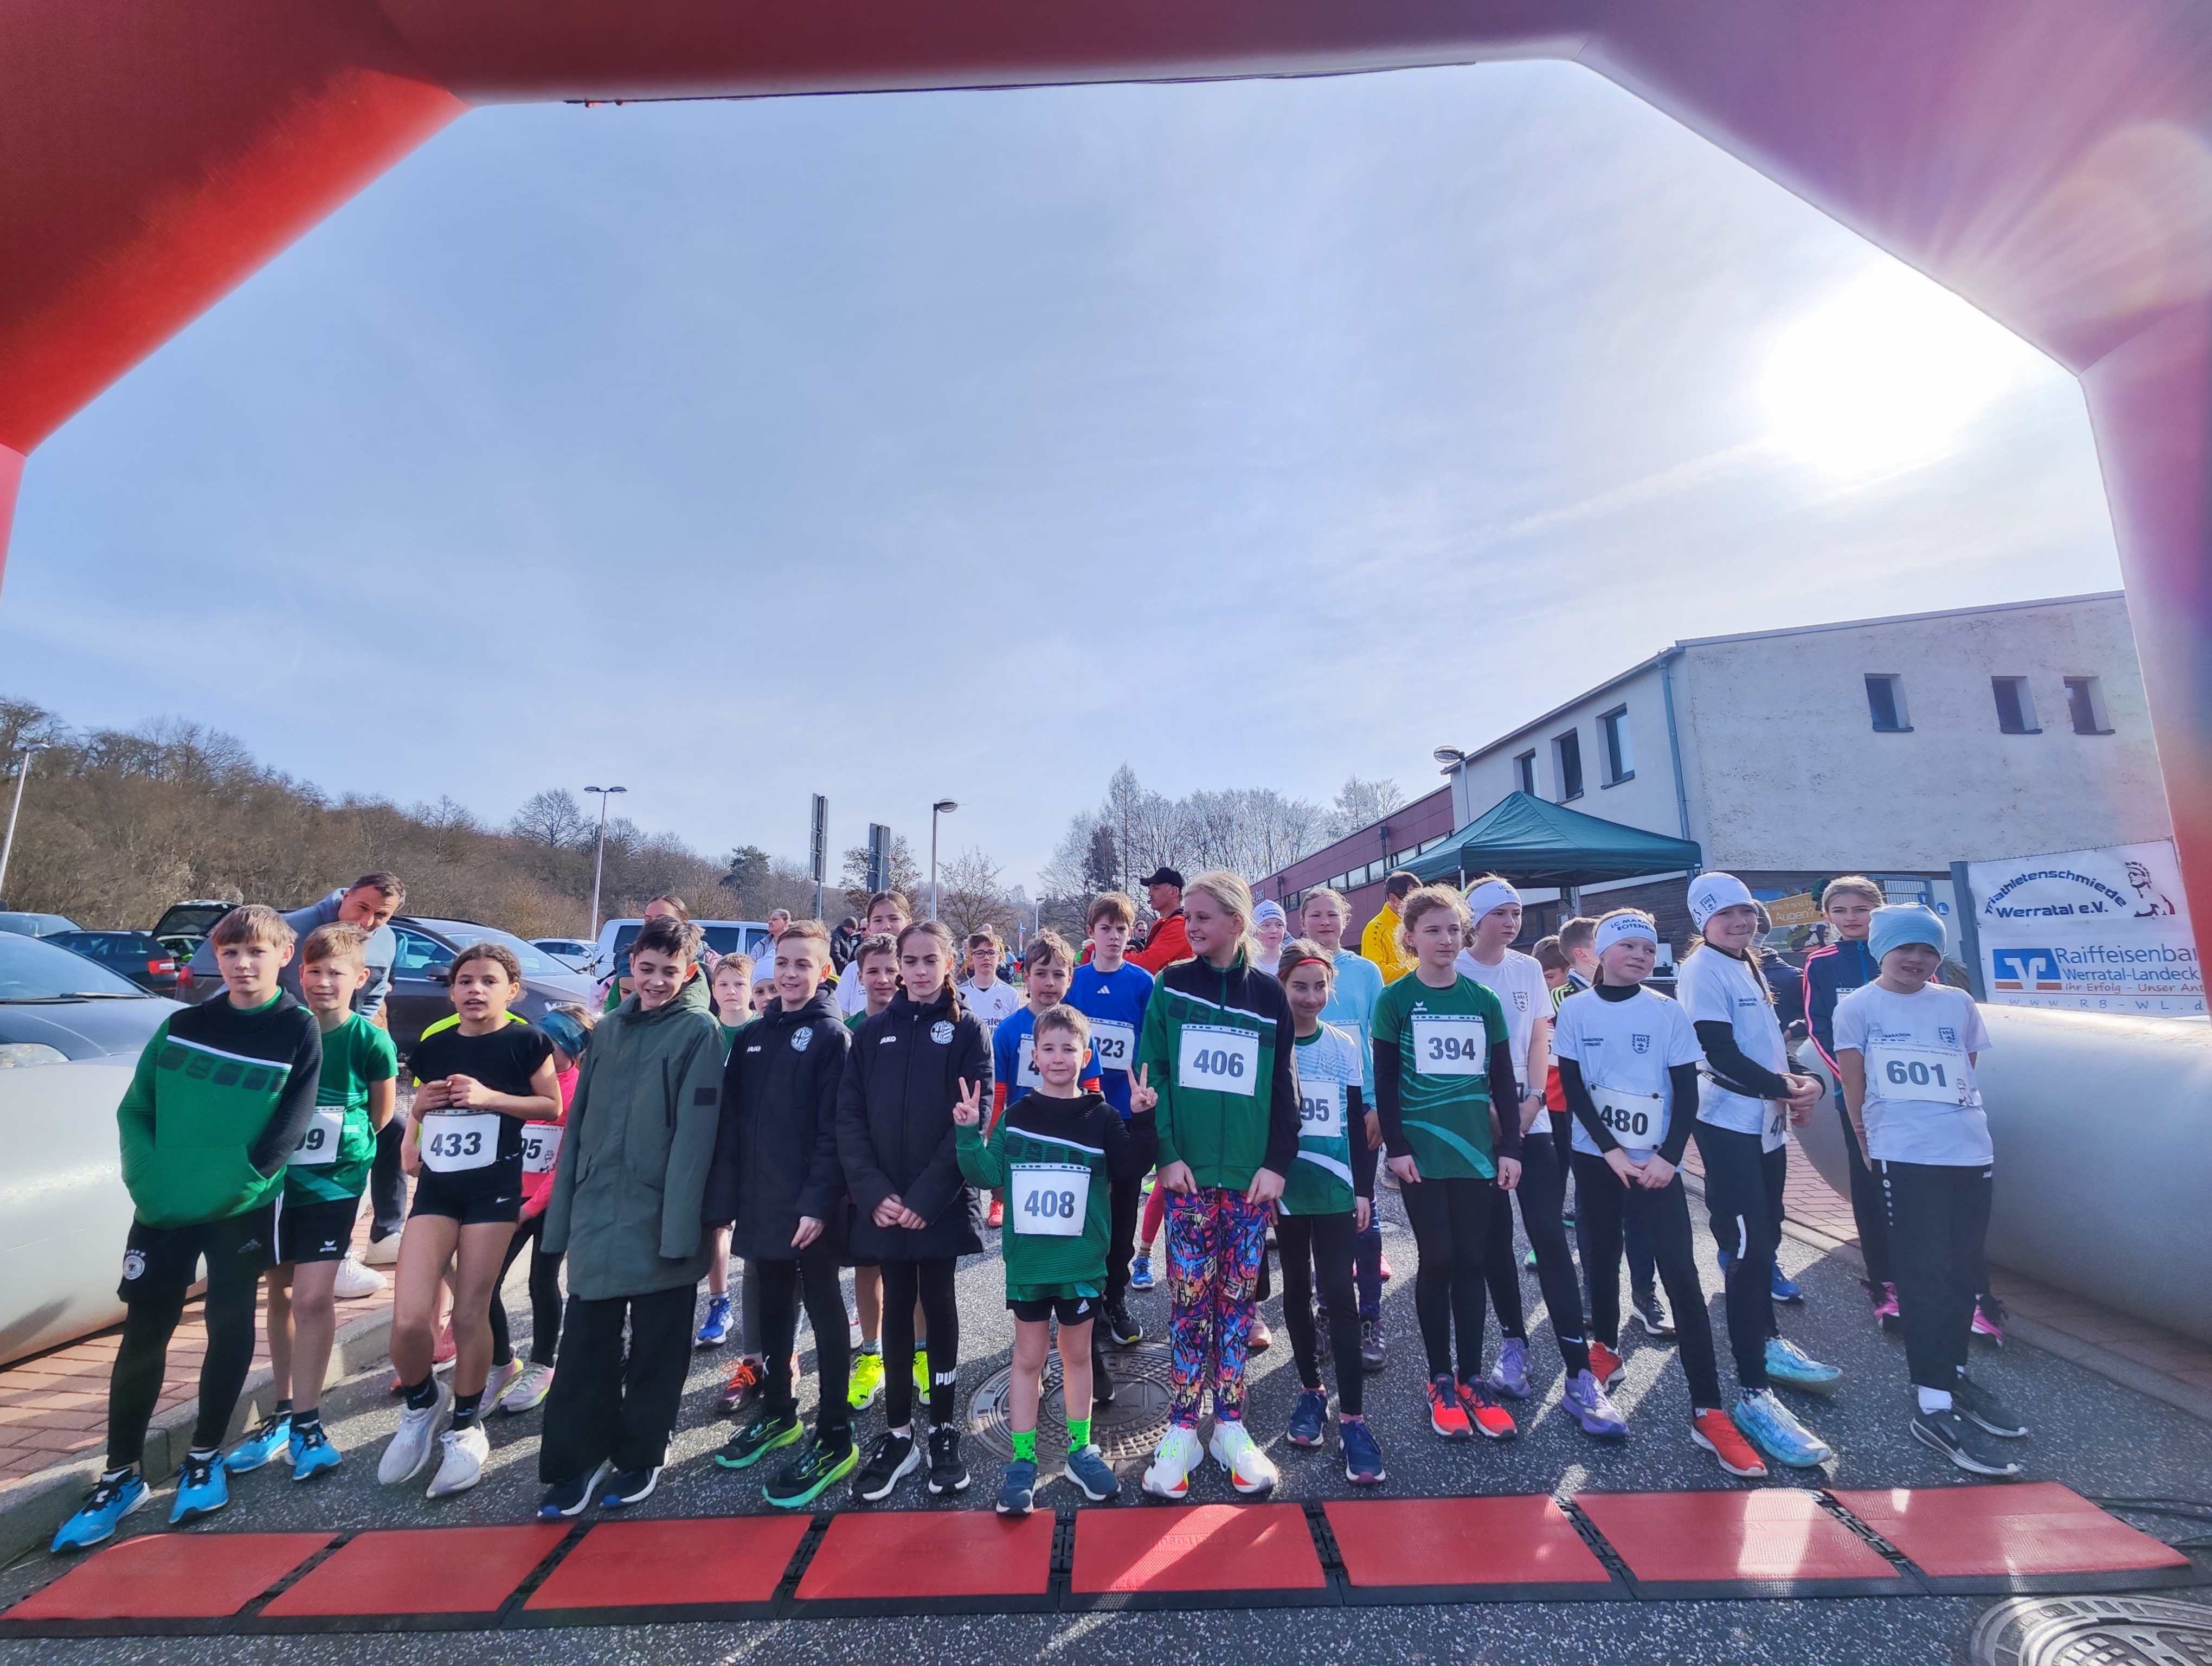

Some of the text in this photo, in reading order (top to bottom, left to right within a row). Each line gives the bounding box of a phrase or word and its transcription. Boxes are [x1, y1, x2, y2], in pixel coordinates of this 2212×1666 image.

[1985, 870, 2127, 915] Triathletenschmiede
[1776, 907, 1814, 922] Augen?
[1996, 901, 2109, 918] Werratal e.V.
[2062, 966, 2200, 981] Werratal-Landeck
[2065, 983, 2080, 991] Ihr
[2087, 983, 2121, 994] Erfolg
[2138, 984, 2175, 992] Unser
[879, 1036, 897, 1045] JAKO
[1428, 1037, 1476, 1060] 394
[1193, 1049, 1244, 1078] 406
[1886, 1060, 1947, 1087] 601
[1600, 1104, 1648, 1136] 480
[430, 1132, 483, 1157] 433
[1024, 1190, 1075, 1219] 408
